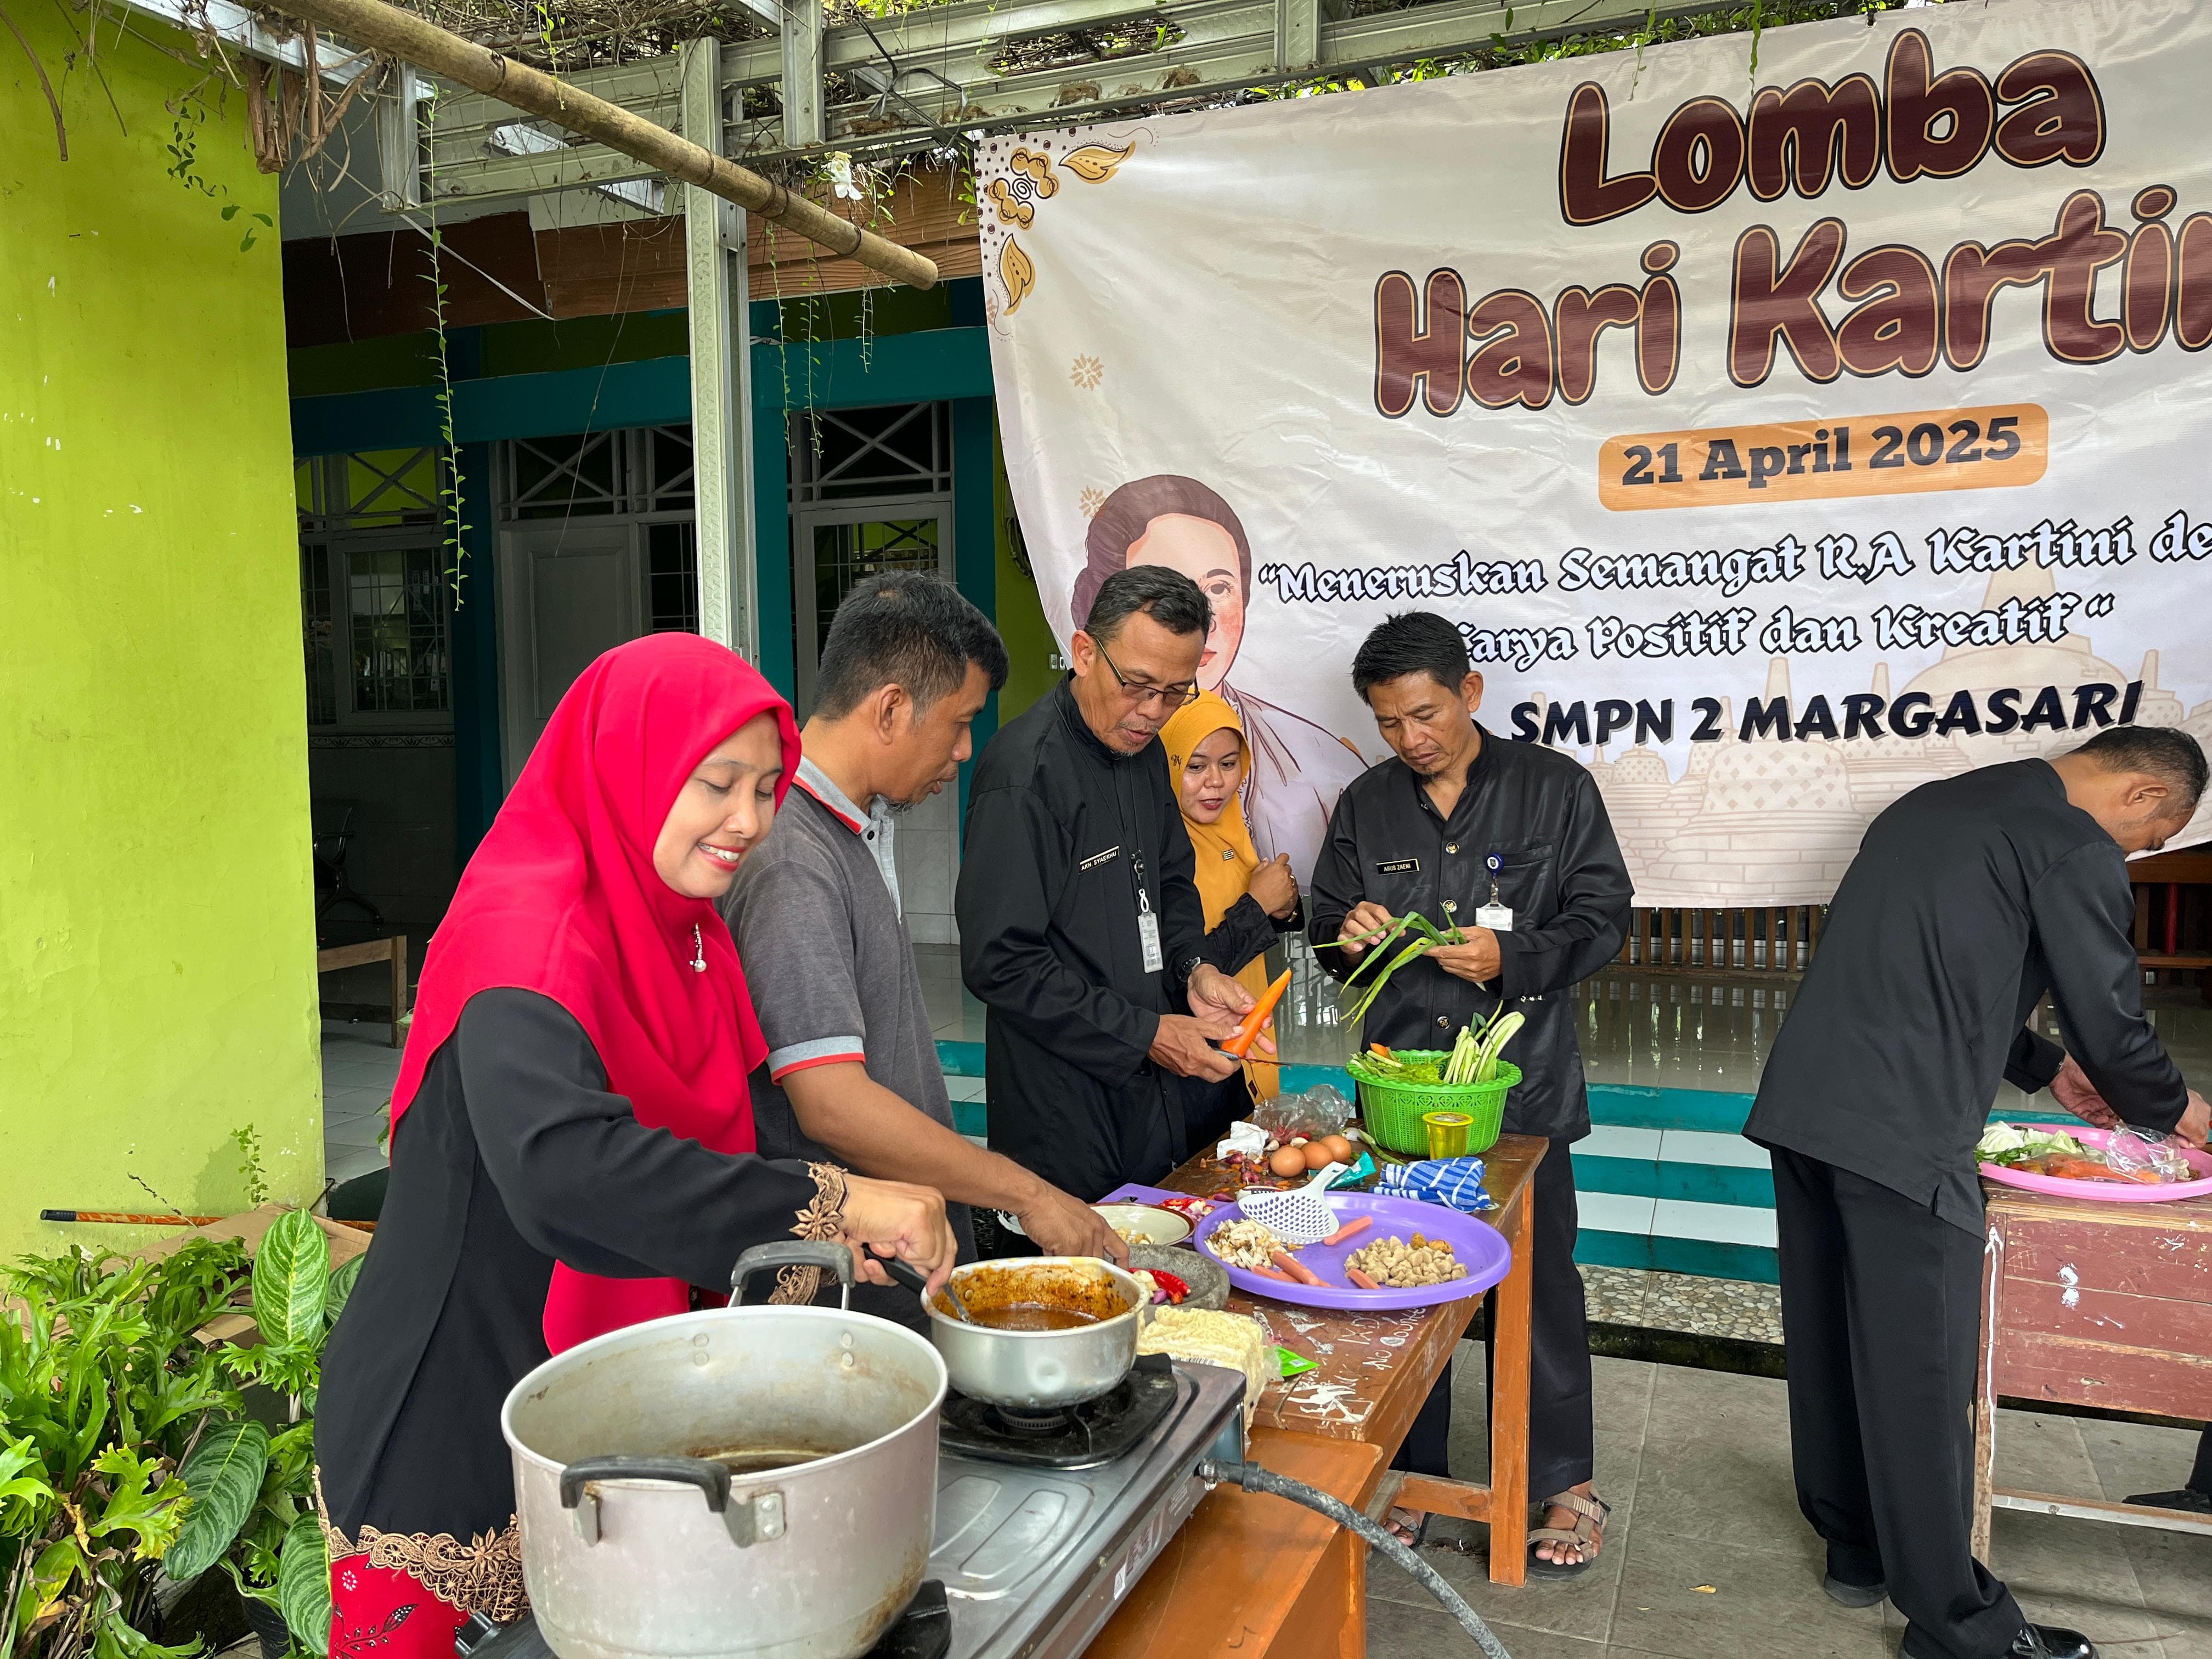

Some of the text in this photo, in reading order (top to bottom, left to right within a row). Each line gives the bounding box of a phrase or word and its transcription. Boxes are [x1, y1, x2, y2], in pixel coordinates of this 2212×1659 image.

[1559, 27, 2105, 226] Lomba
[1373, 240, 1681, 418] Hari
[1622, 416, 2021, 489] 21 April 2025
[1259, 549, 1548, 603] “Meneruskan
[1558, 533, 1806, 597] Semangat
[1815, 531, 1916, 585] R.A
[1926, 515, 2137, 575] Kartini
[1587, 607, 1756, 659] Positif
[1760, 605, 1863, 654] dan
[1511, 680, 2145, 747] SMPN 2 MARGASARI
